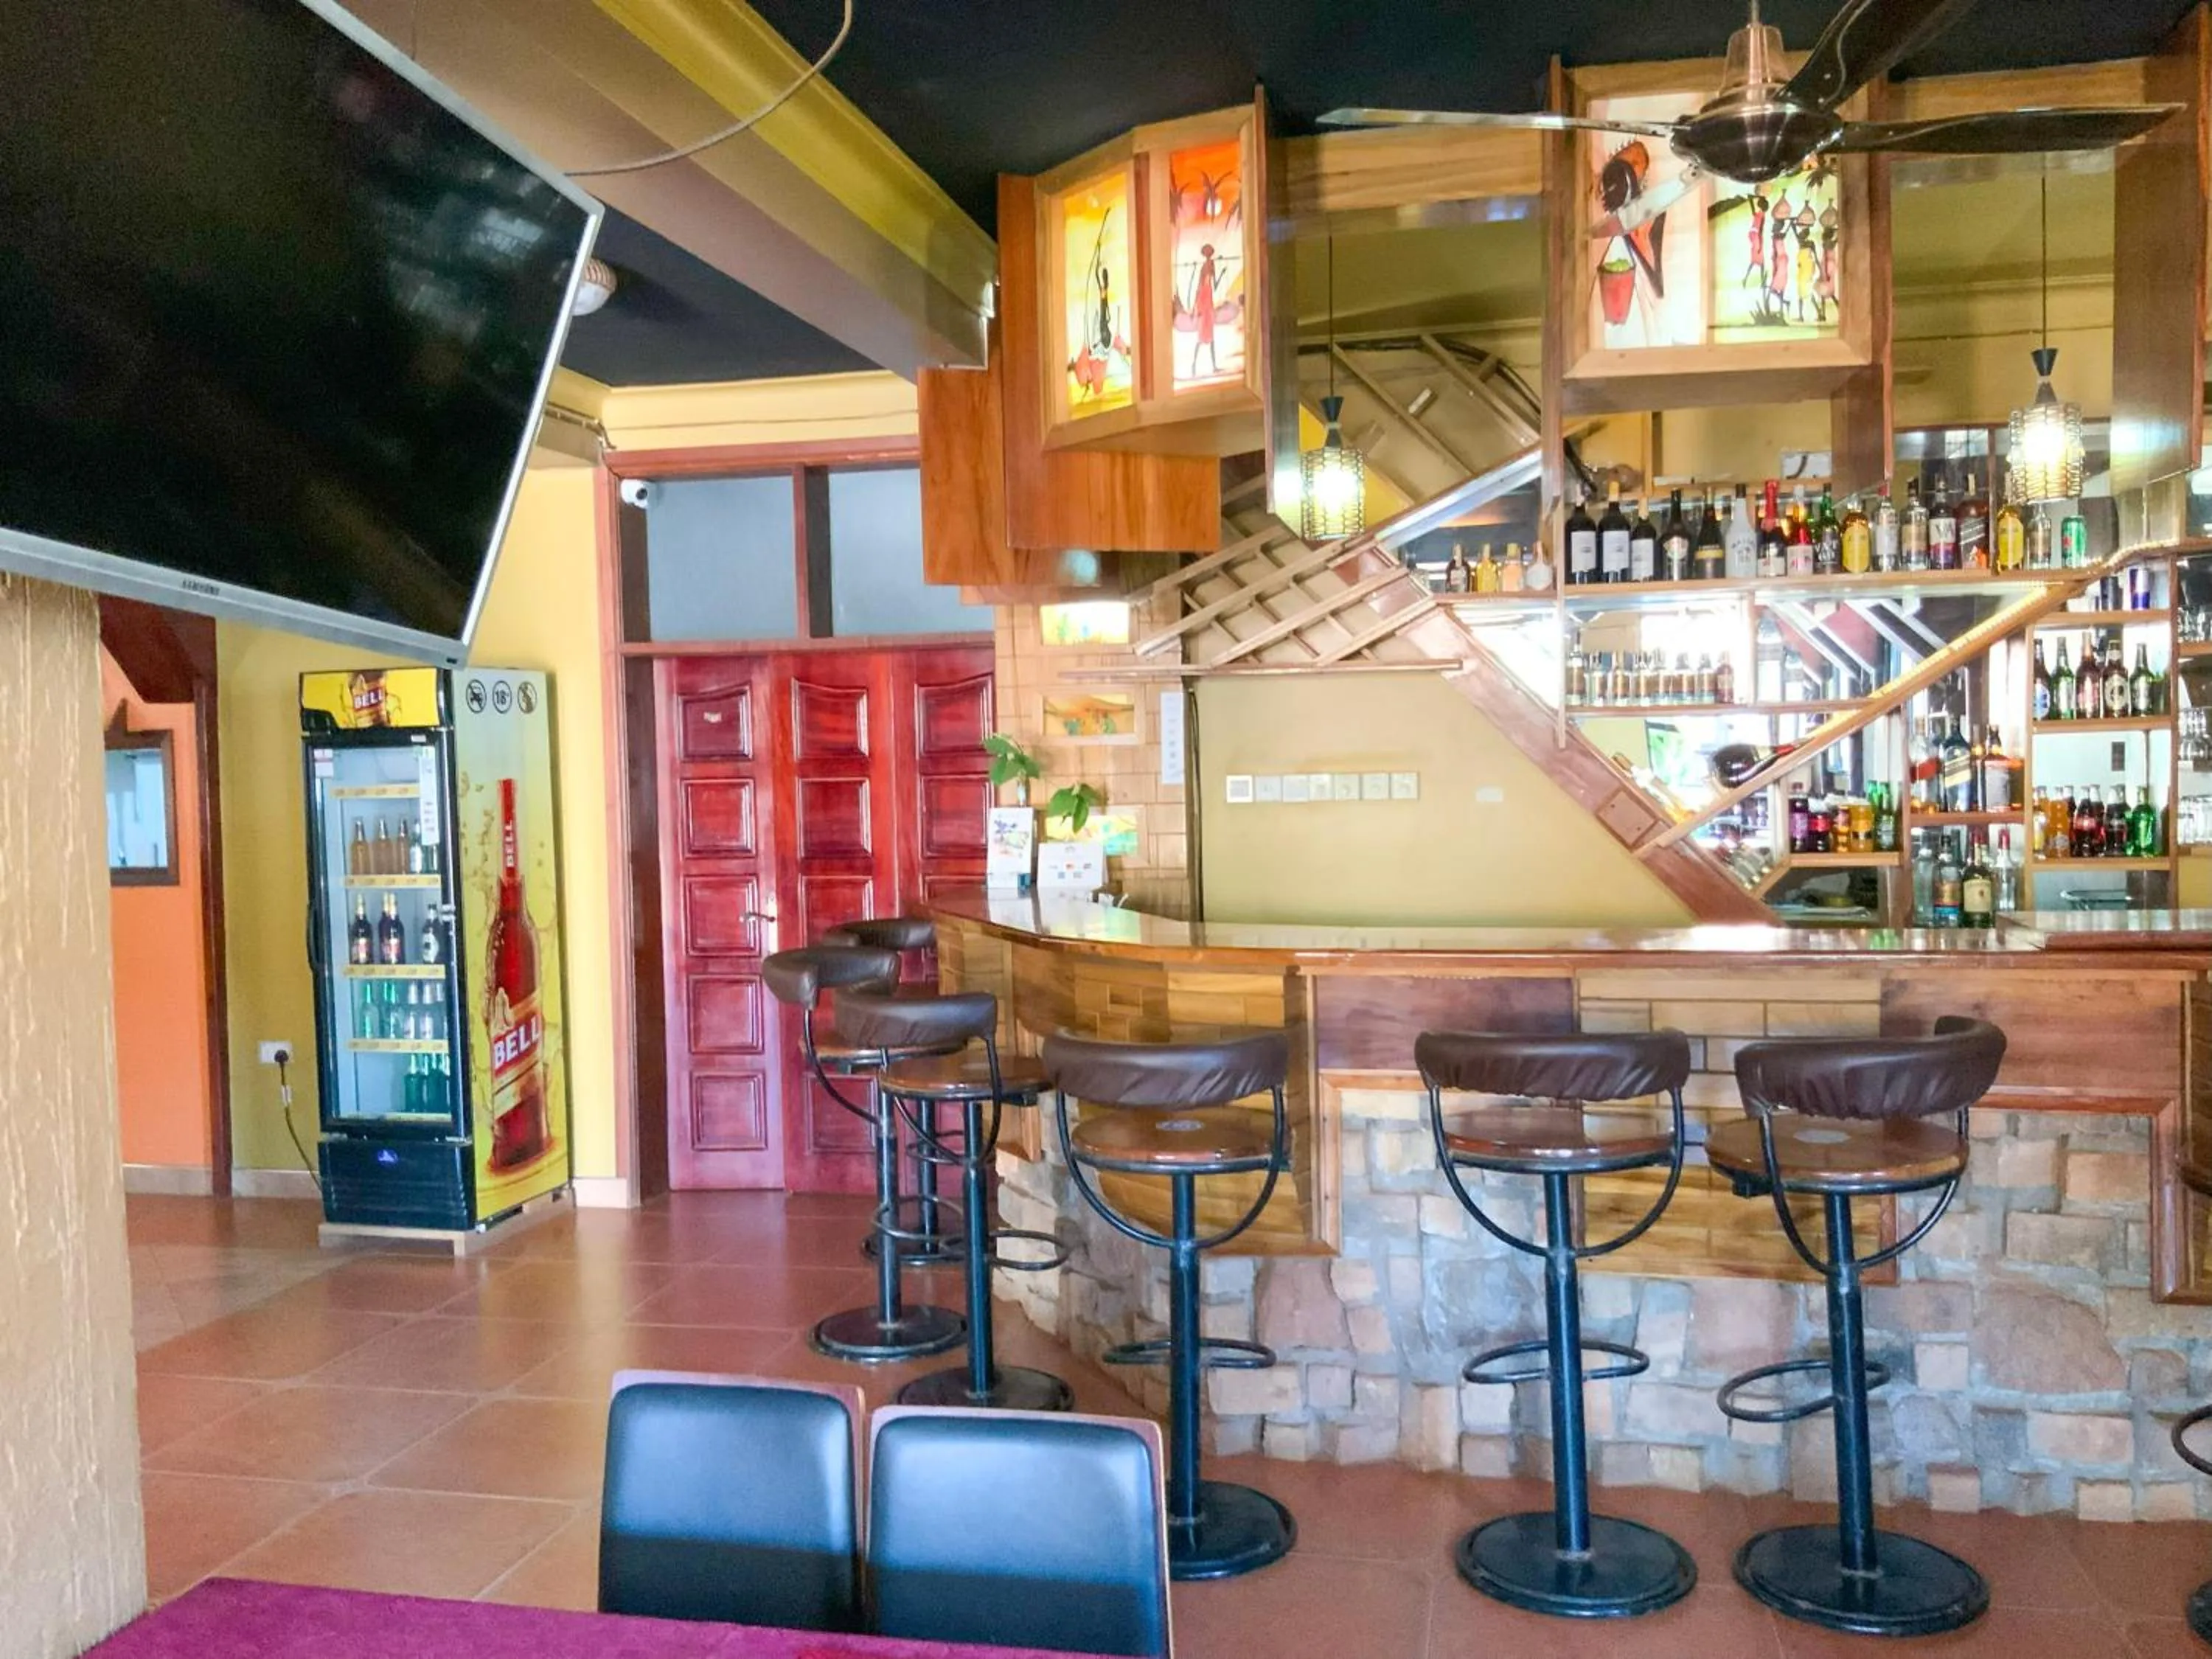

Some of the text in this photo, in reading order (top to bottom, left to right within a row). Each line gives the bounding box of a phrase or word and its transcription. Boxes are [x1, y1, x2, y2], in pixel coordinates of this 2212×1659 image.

[354, 688, 383, 709] BELL
[504, 819, 515, 867] BELL
[494, 1015, 540, 1069] BELL
